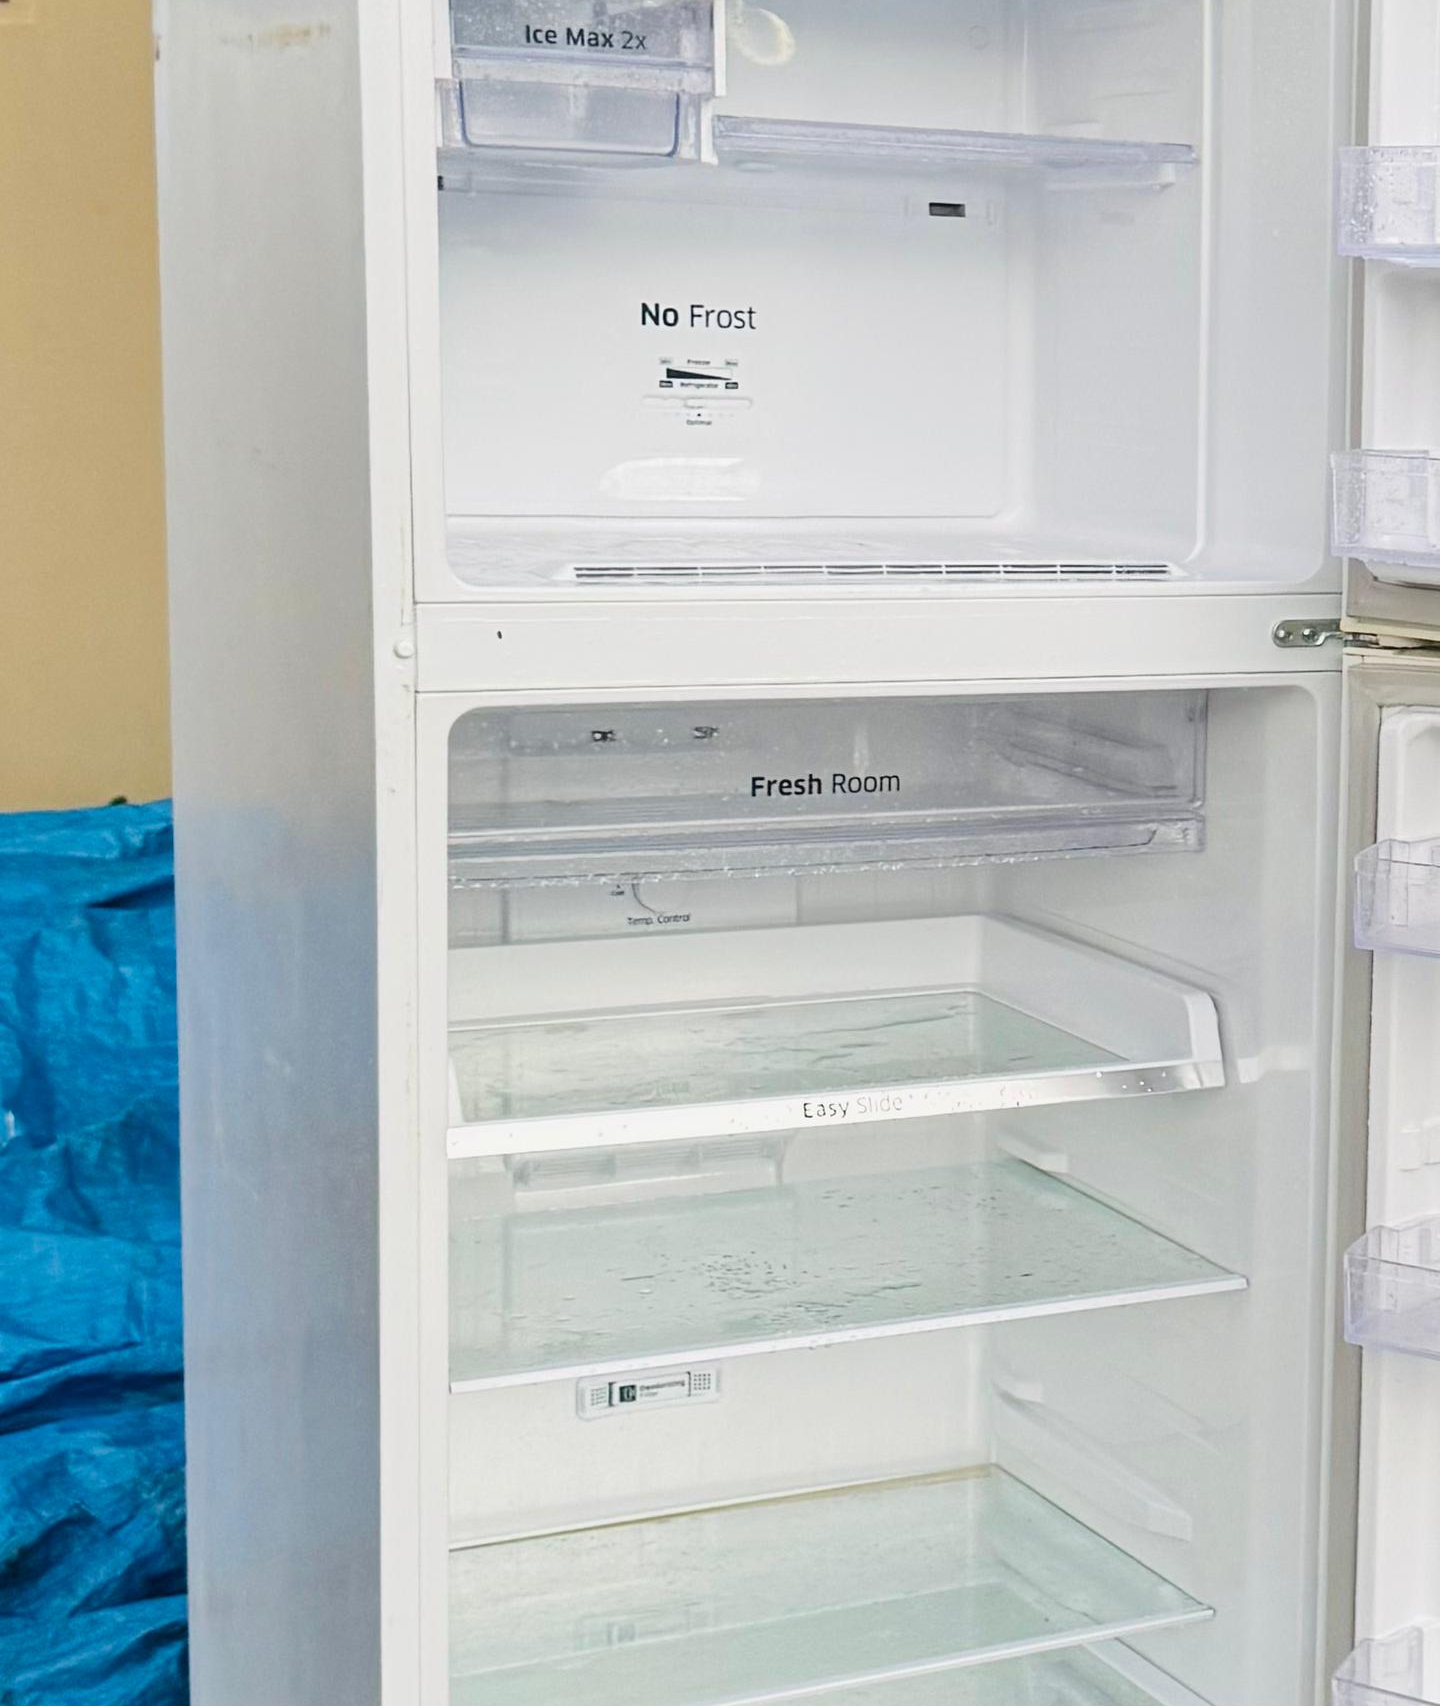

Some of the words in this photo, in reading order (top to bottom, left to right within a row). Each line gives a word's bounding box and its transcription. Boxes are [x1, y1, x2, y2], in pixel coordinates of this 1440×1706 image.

[525, 24, 558, 44] Ice
[566, 27, 614, 48] Max
[621, 30, 647, 50] 2x
[641, 302, 679, 327] No
[690, 304, 757, 330] Frost
[751, 773, 823, 797] Fresh
[832, 773, 900, 794] Room
[803, 1101, 849, 1118] Easy
[856, 1095, 903, 1114] Slide
